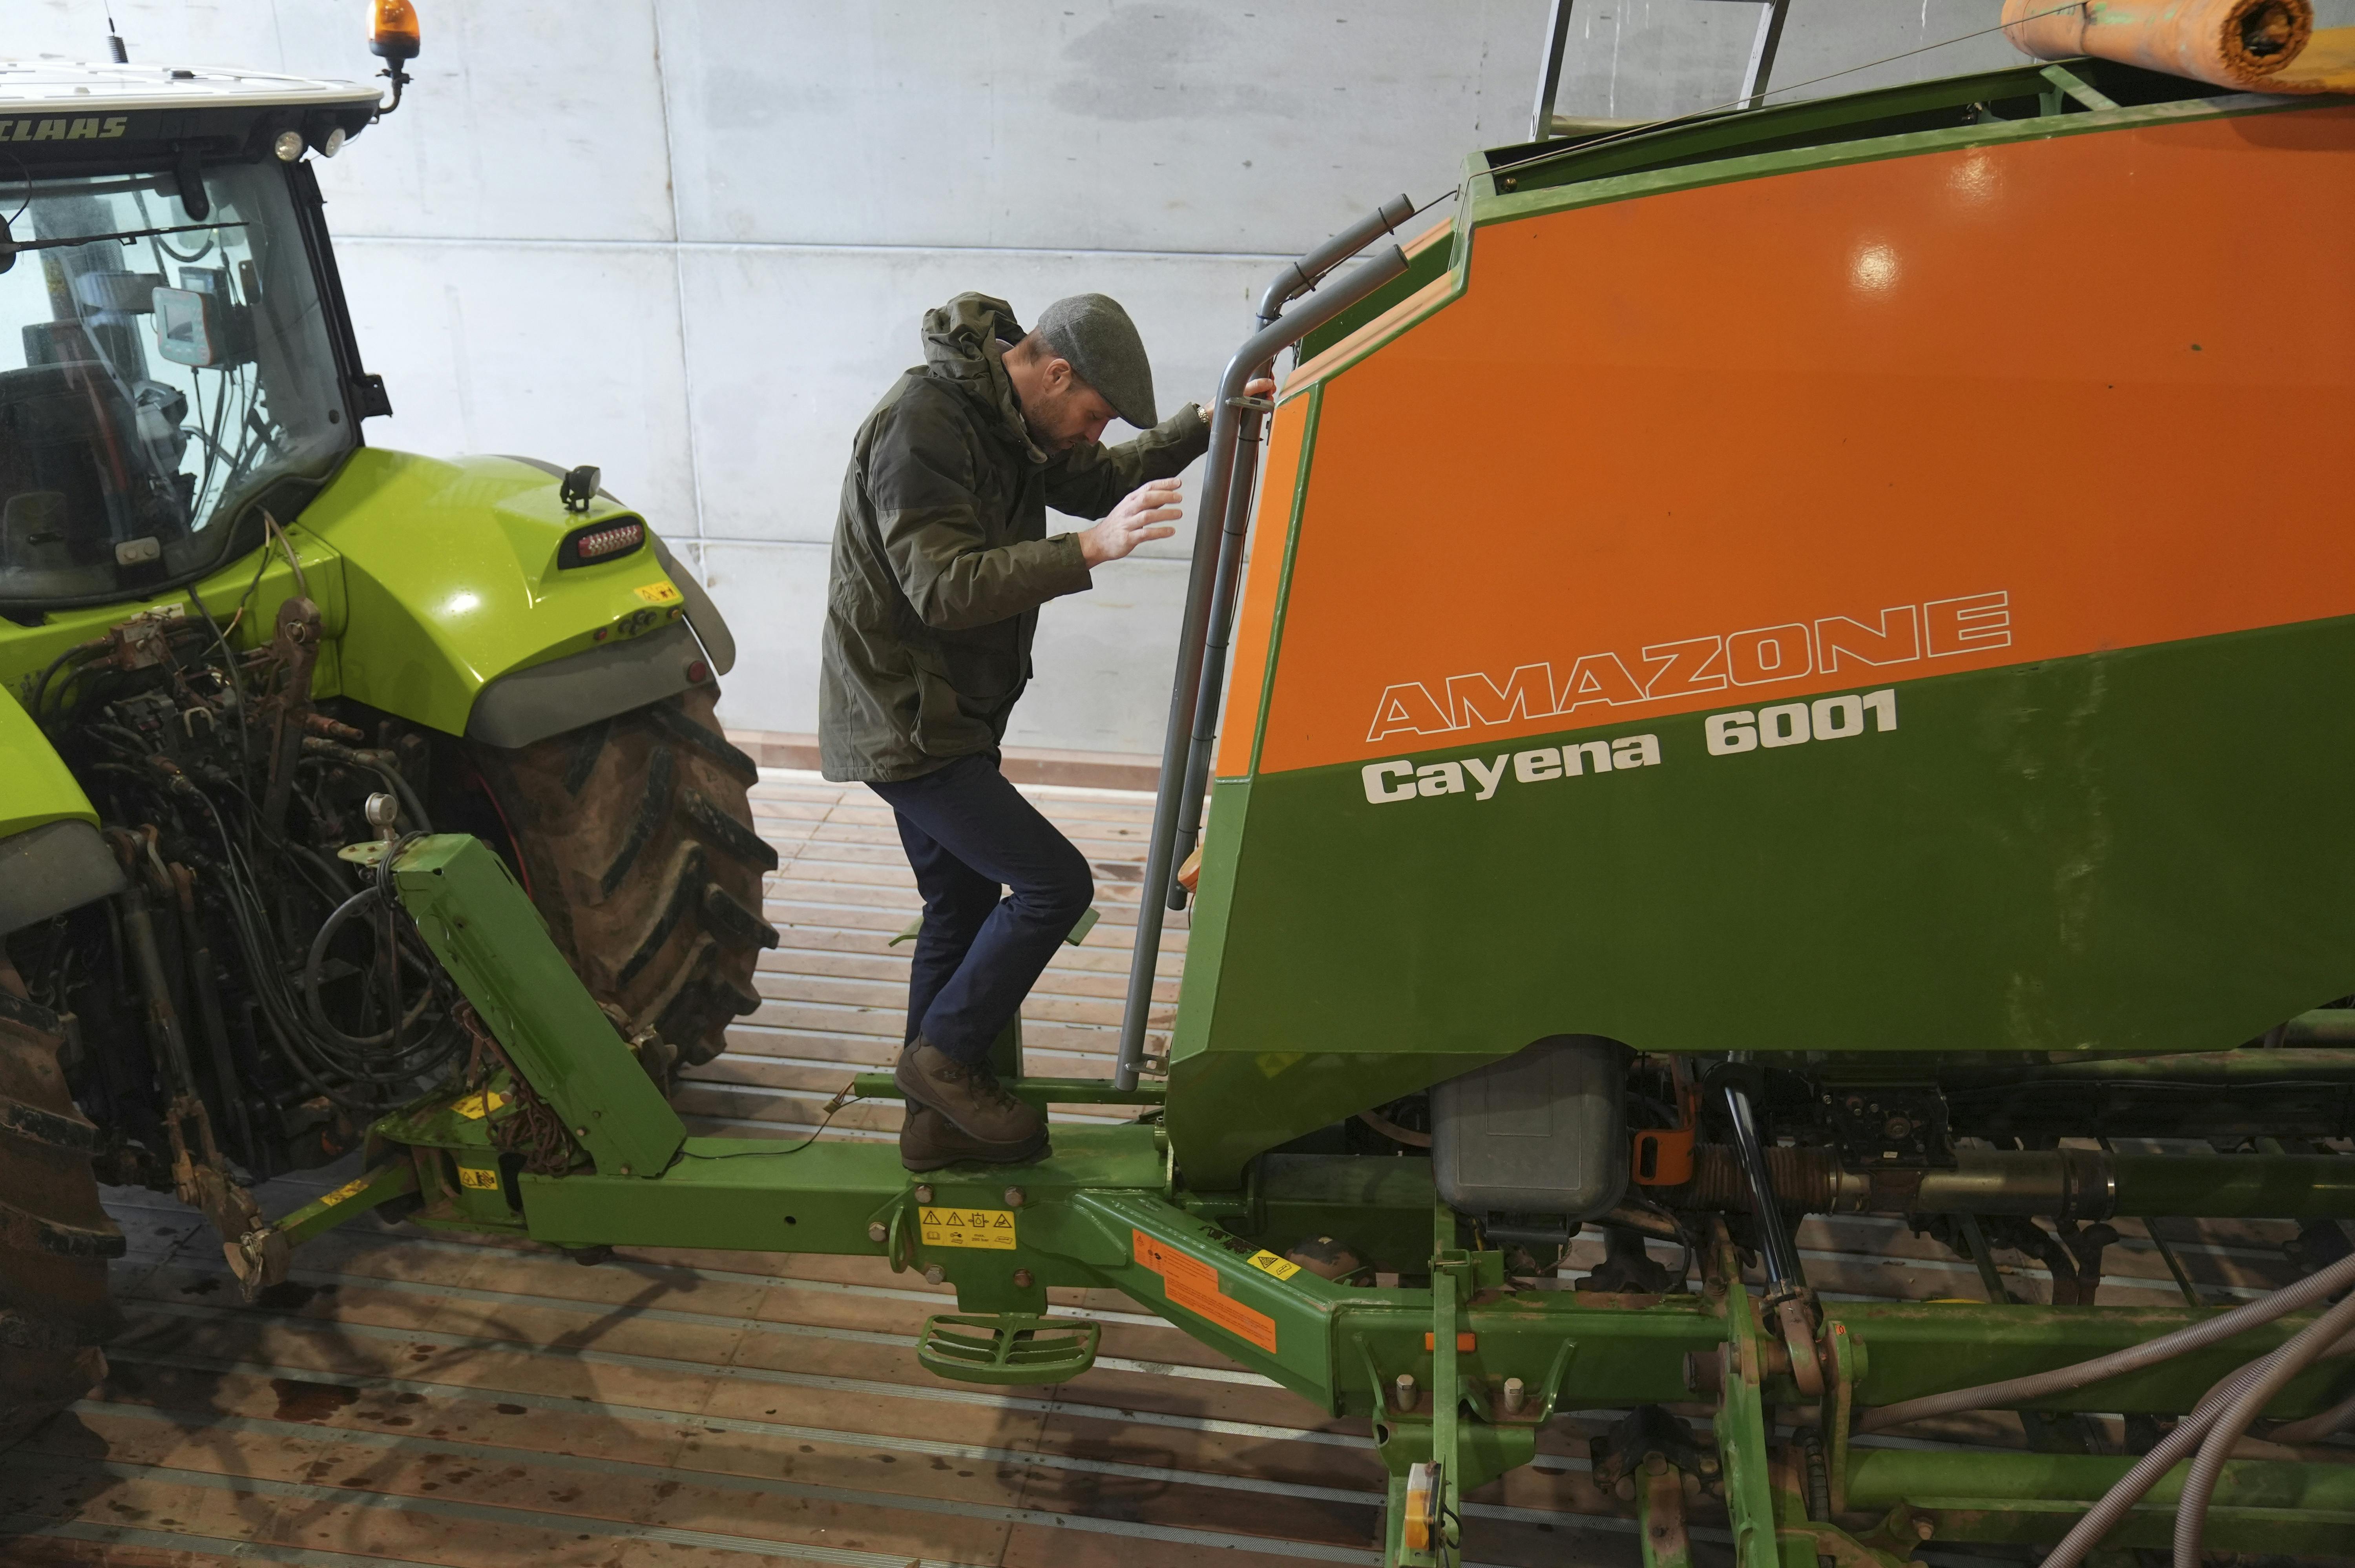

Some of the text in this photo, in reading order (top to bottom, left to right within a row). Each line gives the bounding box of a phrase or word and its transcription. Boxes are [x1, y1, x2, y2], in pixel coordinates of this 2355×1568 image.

[0, 117, 128, 141] CLAAS
[1366, 590, 2011, 742] AMAZONE
[1362, 689, 1897, 804] Cayena 6001
